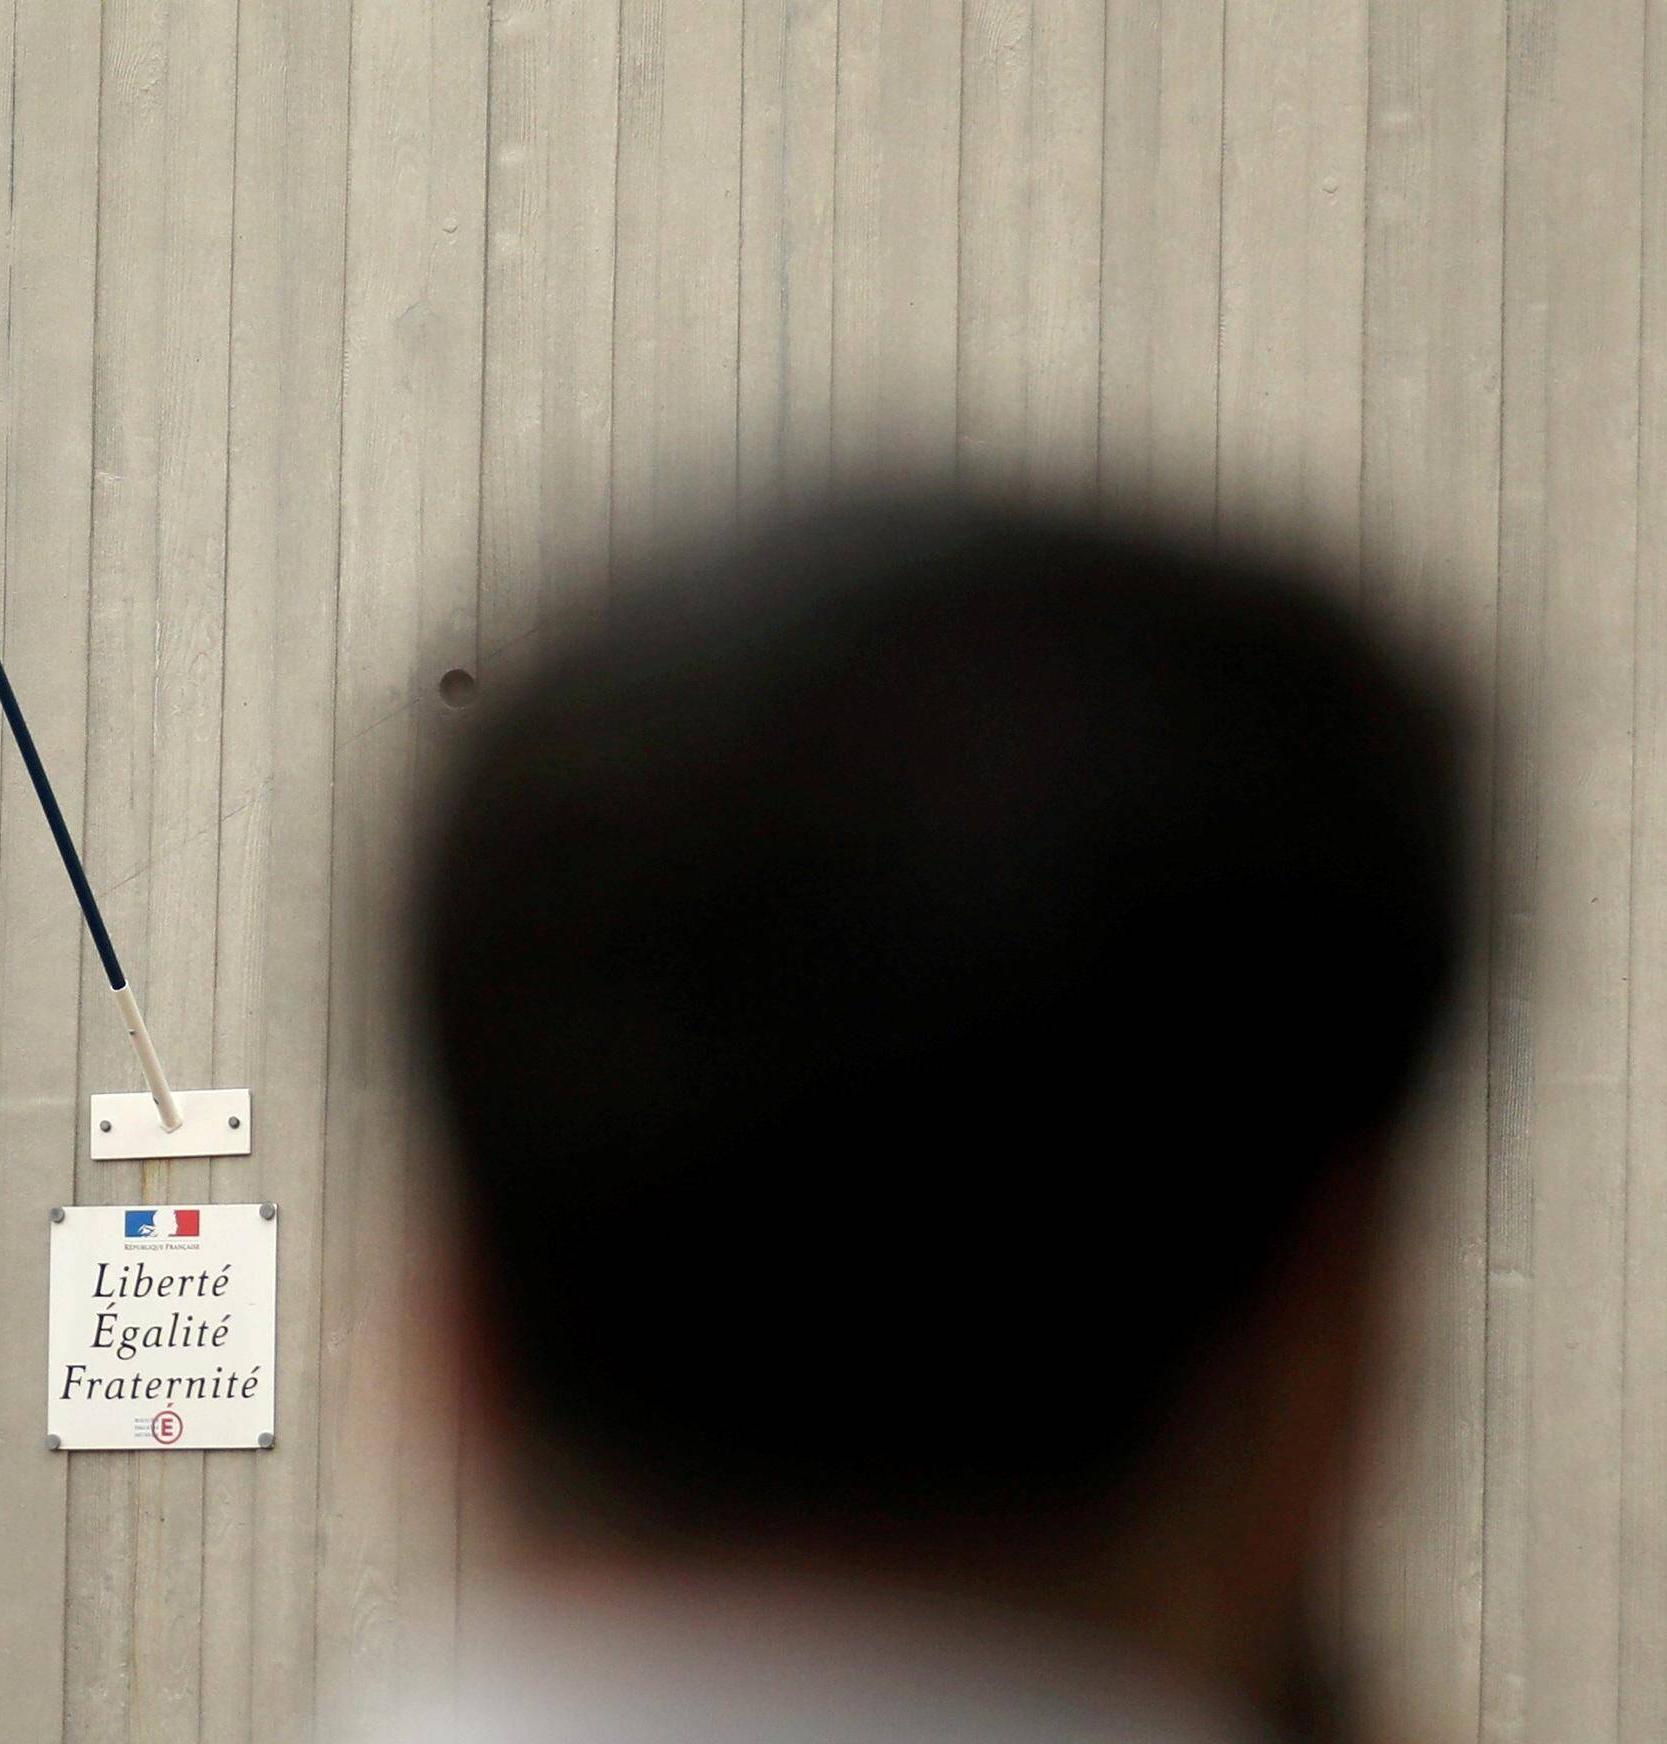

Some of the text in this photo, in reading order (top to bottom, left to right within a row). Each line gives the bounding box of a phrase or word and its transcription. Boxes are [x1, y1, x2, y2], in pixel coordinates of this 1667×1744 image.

[92, 1263, 231, 1297] Liberté
[90, 1303, 231, 1360] Égalité
[60, 1365, 260, 1399] Fraternité
